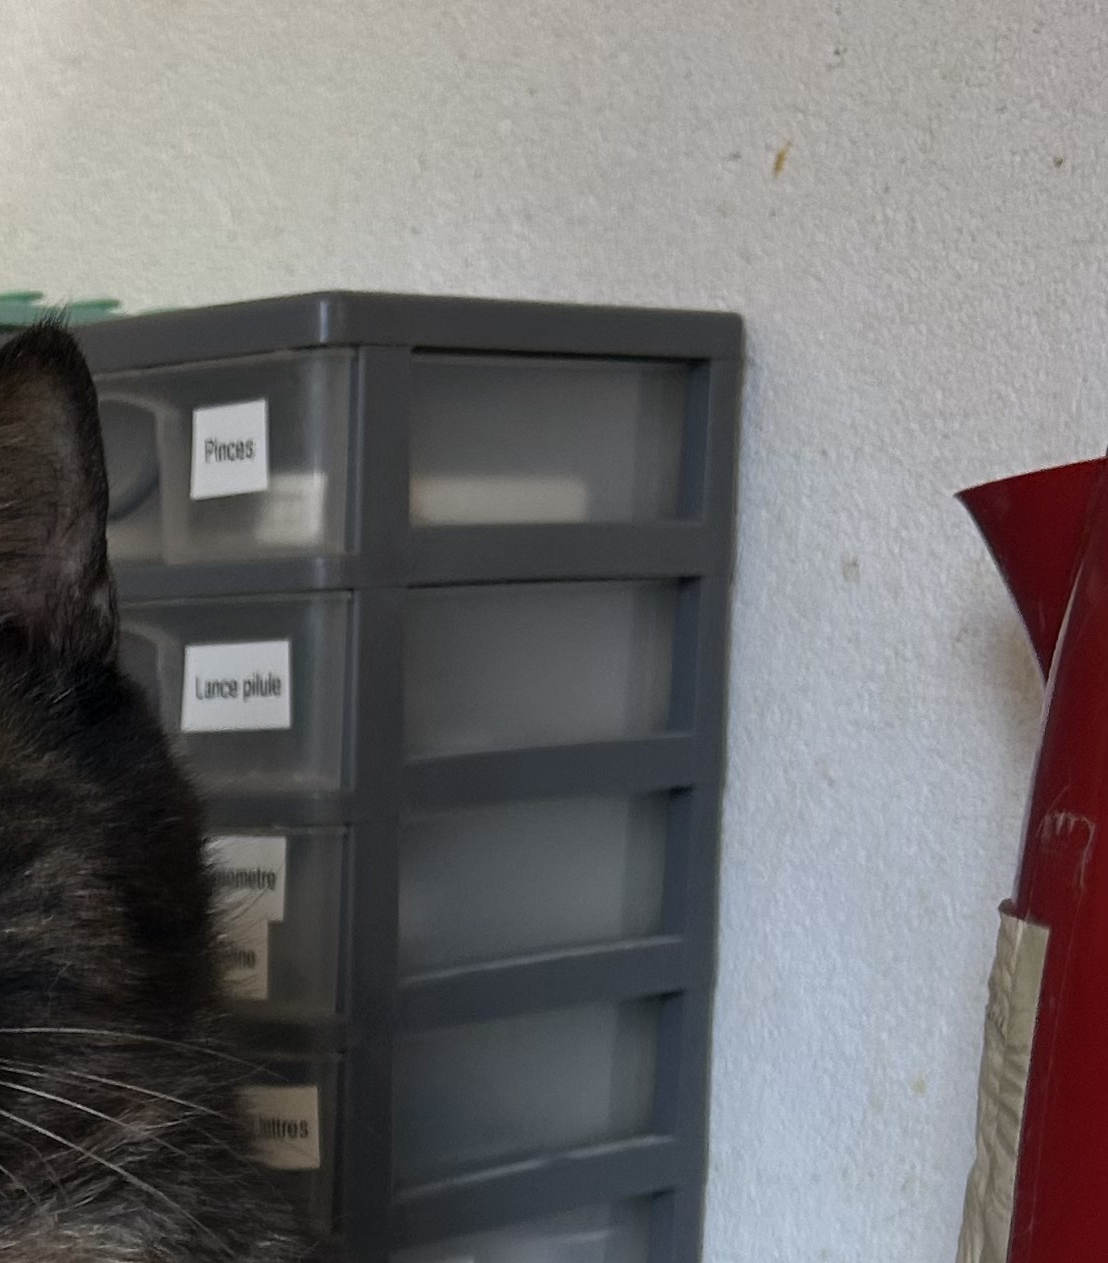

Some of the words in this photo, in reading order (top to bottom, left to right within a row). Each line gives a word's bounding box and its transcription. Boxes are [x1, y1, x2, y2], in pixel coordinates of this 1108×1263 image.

[203, 437, 255, 464] Pinces
[194, 676, 238, 700] Lance
[242, 672, 282, 703] pilule
